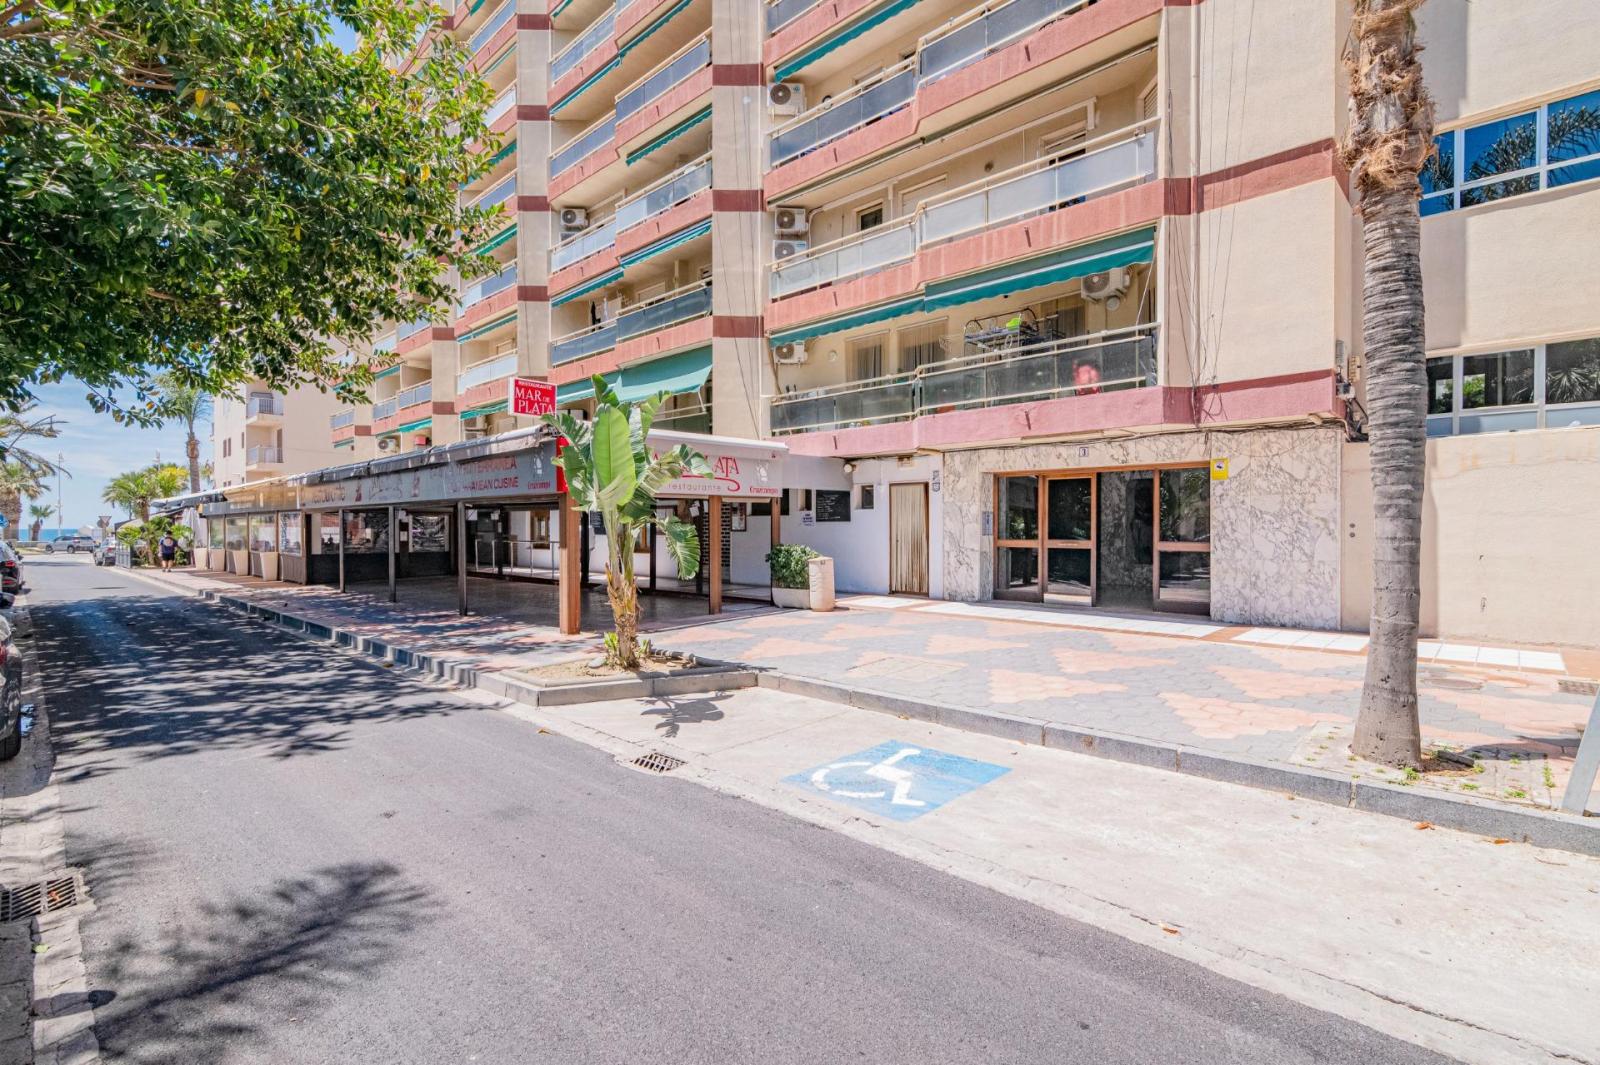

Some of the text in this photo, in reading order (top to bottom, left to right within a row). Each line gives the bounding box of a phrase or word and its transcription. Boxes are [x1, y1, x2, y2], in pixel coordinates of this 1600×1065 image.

[515, 386, 542, 402] MAR
[518, 399, 555, 416] PLATA
[668, 482, 721, 492] restaurante
